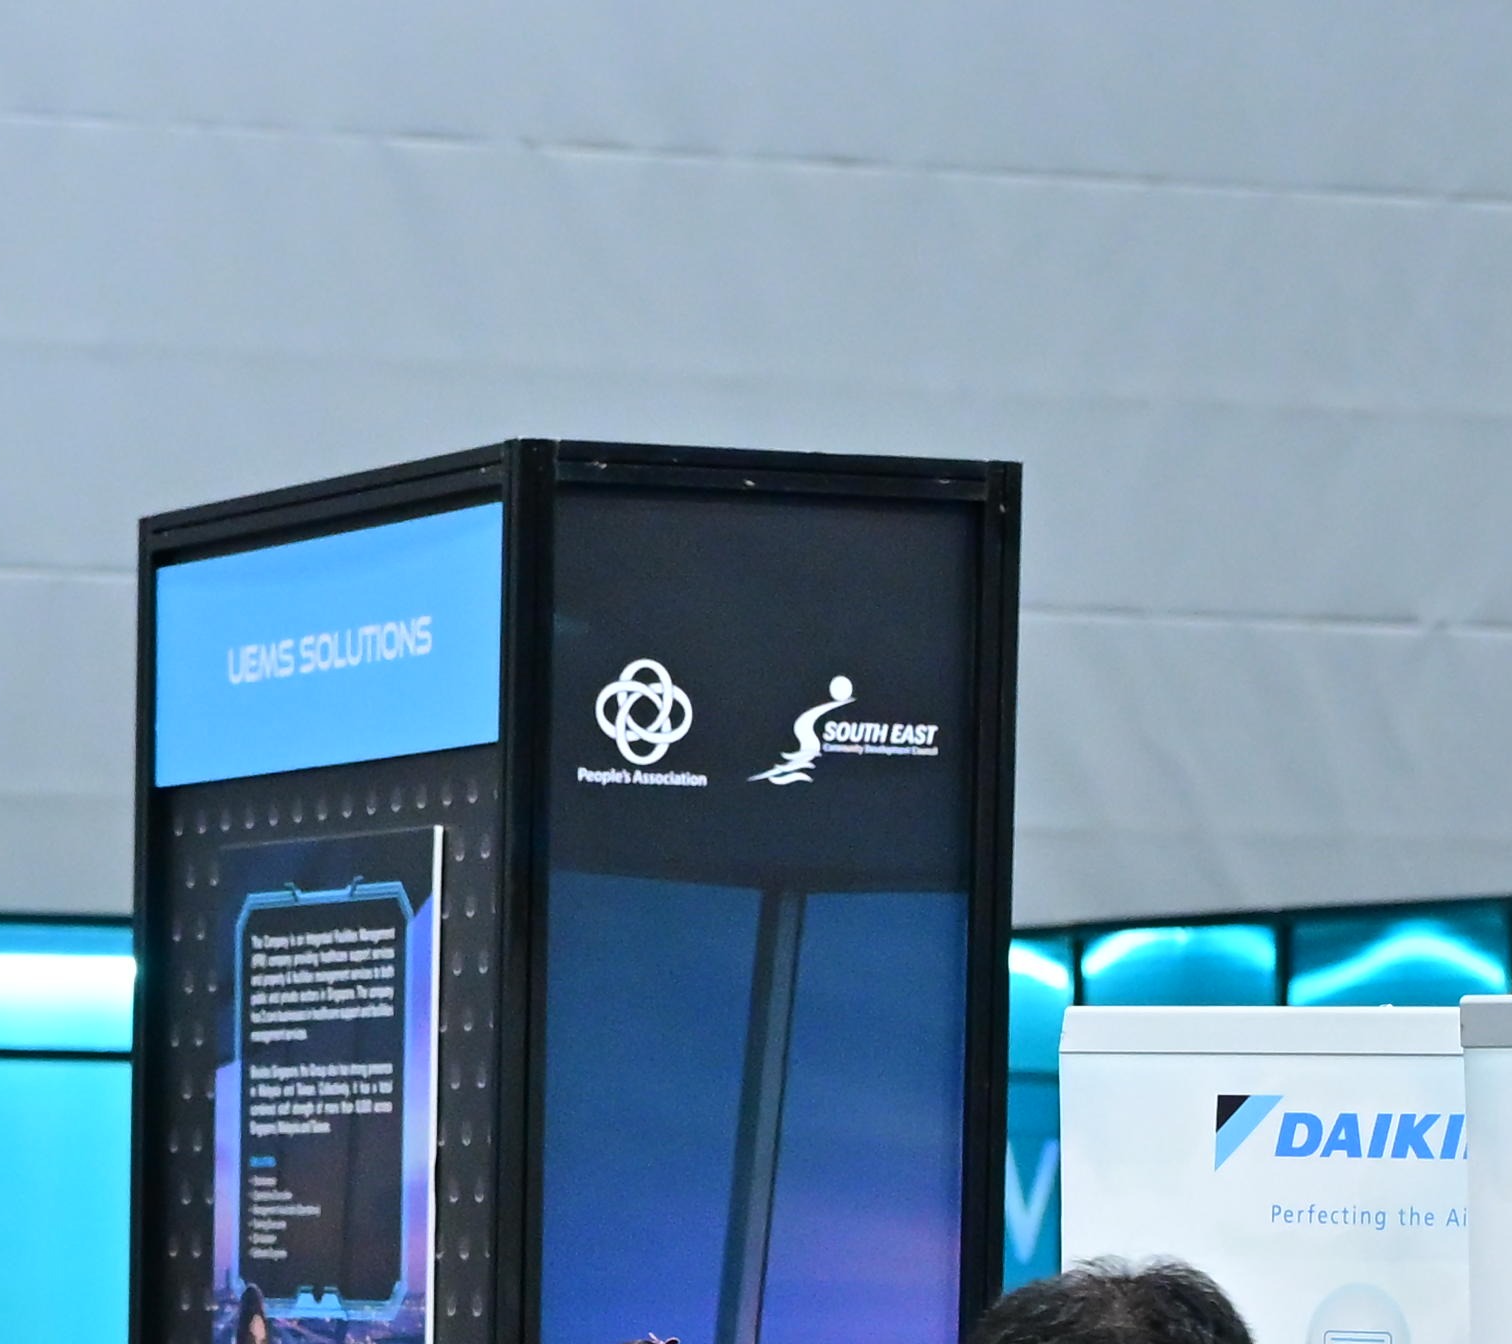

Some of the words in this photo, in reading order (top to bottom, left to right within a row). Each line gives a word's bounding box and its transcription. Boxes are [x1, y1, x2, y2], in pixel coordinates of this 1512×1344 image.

[228, 636, 295, 684] UEMS
[300, 616, 433, 675] SOLUTIONS
[824, 721, 889, 743] SOUTH
[890, 724, 938, 745] EAST
[577, 767, 631, 785] People's
[633, 769, 707, 787] Association
[1274, 1112, 1466, 1159] DAIKI
[1270, 1203, 1388, 1231] Perfecting
[1398, 1205, 1438, 1229] the
[1446, 1207, 1466, 1230] Ai
